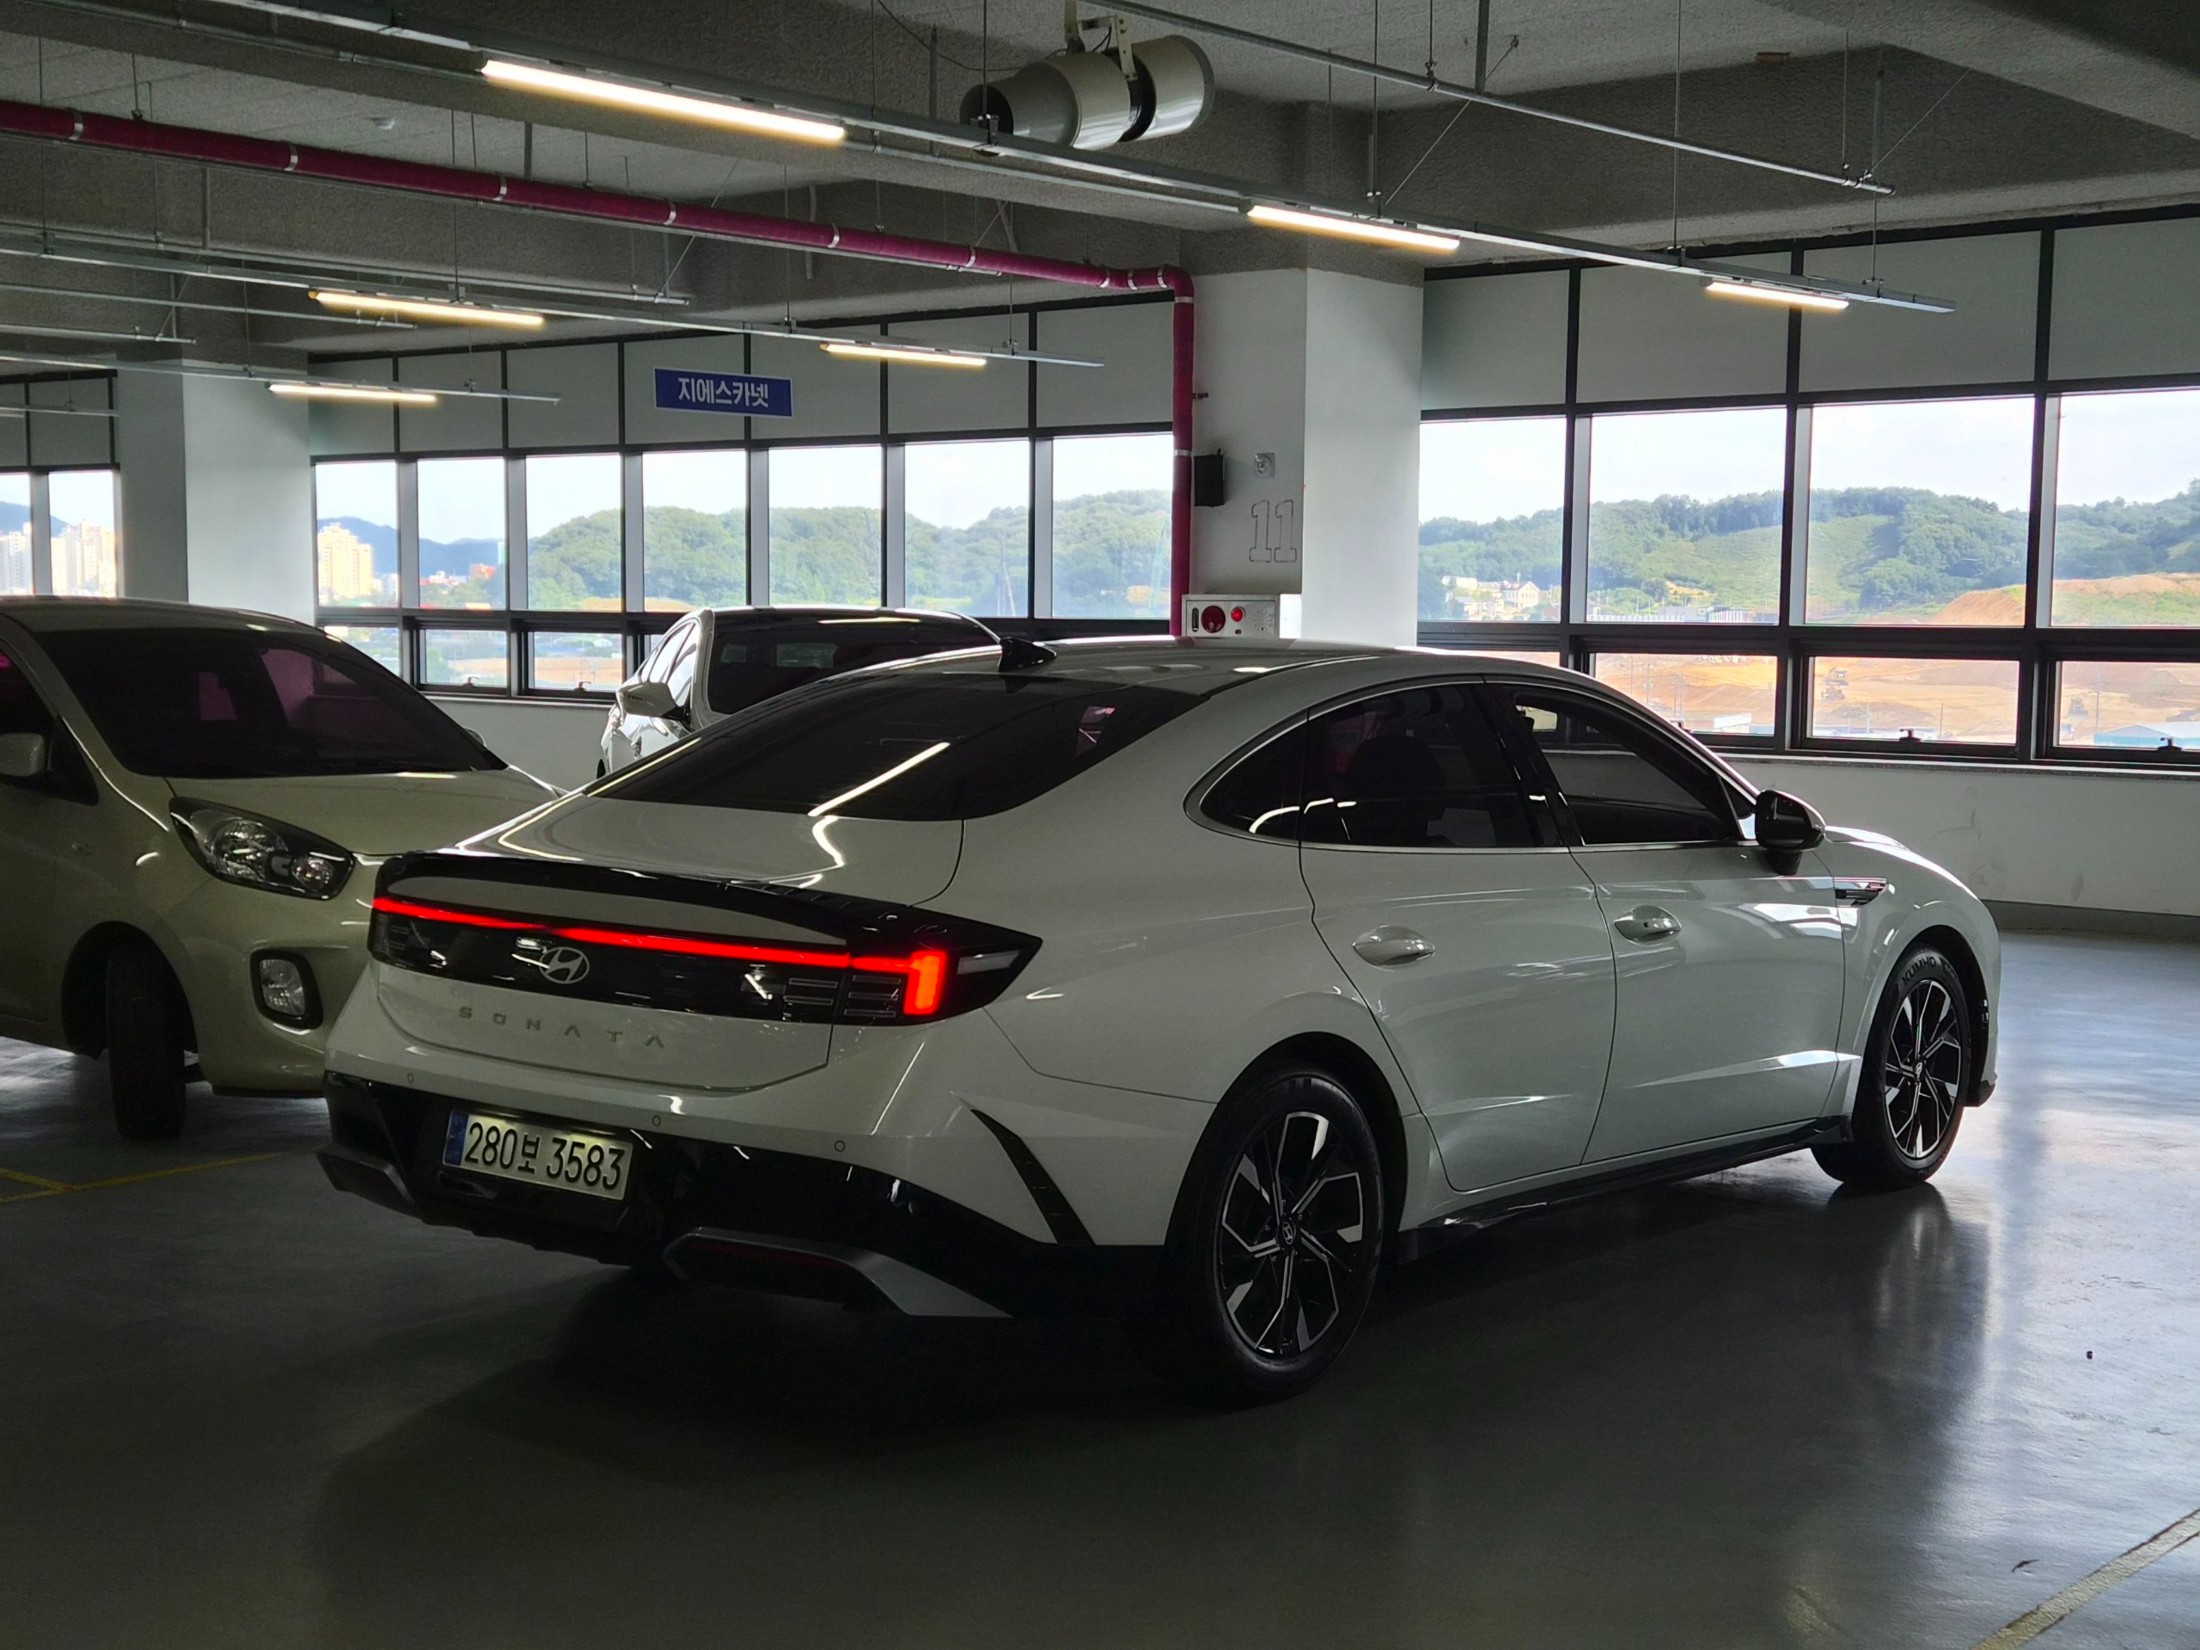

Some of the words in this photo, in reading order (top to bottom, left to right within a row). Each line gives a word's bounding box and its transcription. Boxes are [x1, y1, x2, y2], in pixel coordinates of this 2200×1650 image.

[677, 376, 769, 409] 지에스카넷
[1248, 499, 1298, 563] 11
[458, 1005, 666, 1049] SONATA
[464, 1121, 541, 1174] 280보
[545, 1136, 626, 1191] 3583
